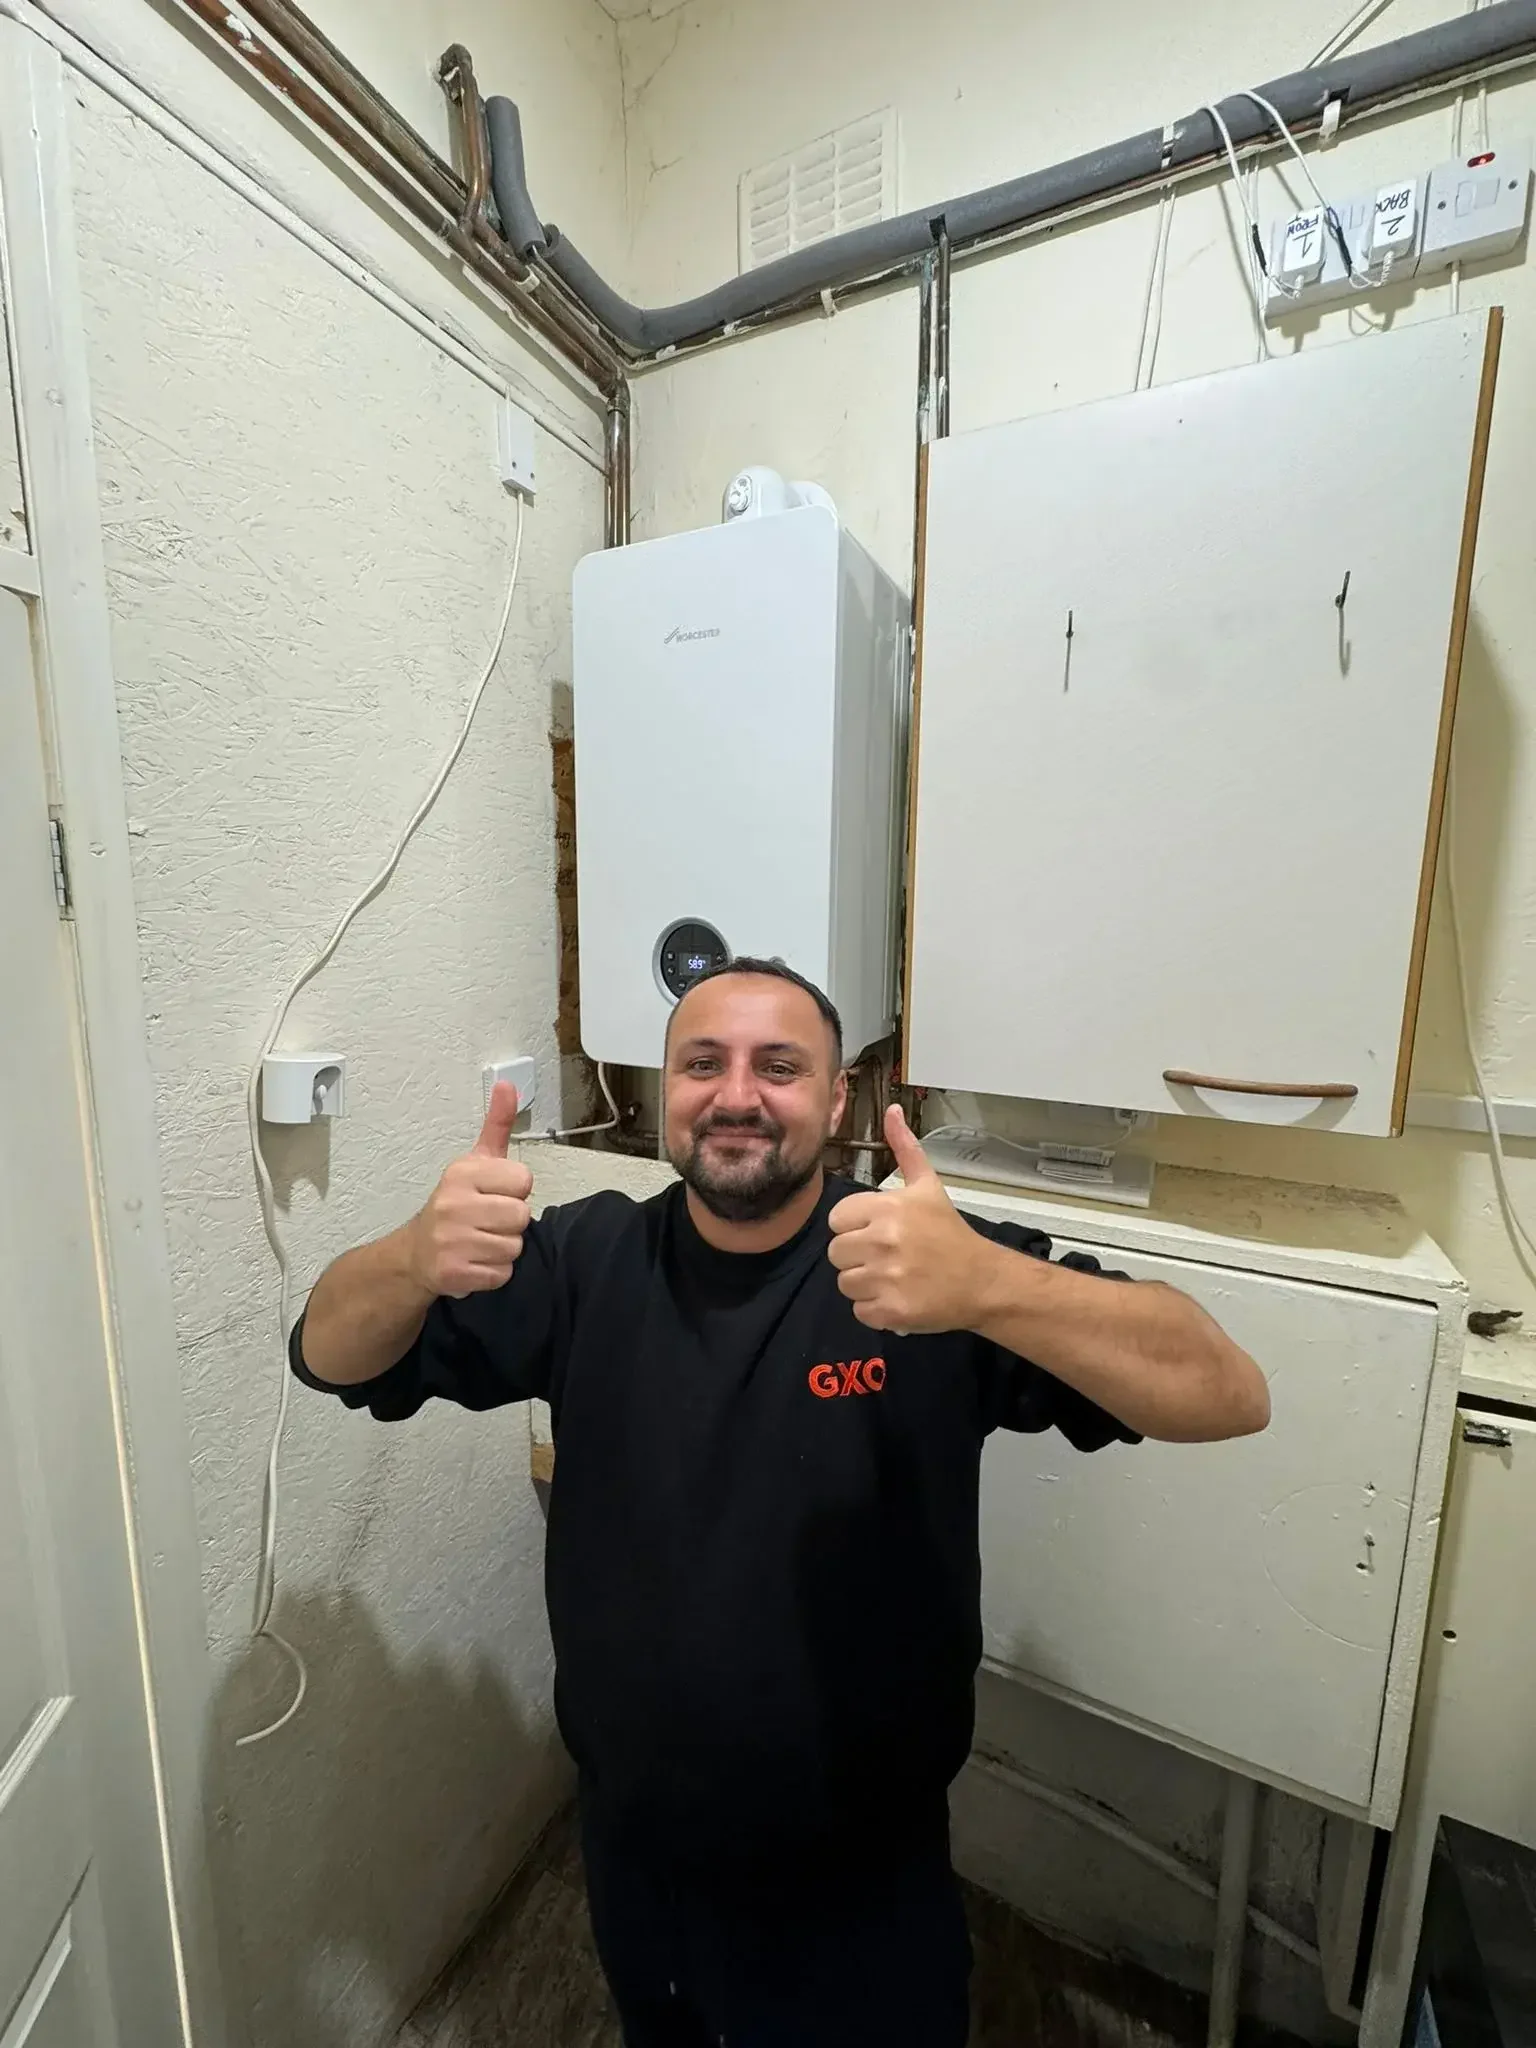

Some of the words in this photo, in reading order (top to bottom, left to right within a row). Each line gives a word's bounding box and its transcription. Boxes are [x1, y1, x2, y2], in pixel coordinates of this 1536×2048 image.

[1374, 188, 1411, 215] BACK
[1380, 215, 1406, 237] 2
[676, 628, 721, 643] WORCESTER
